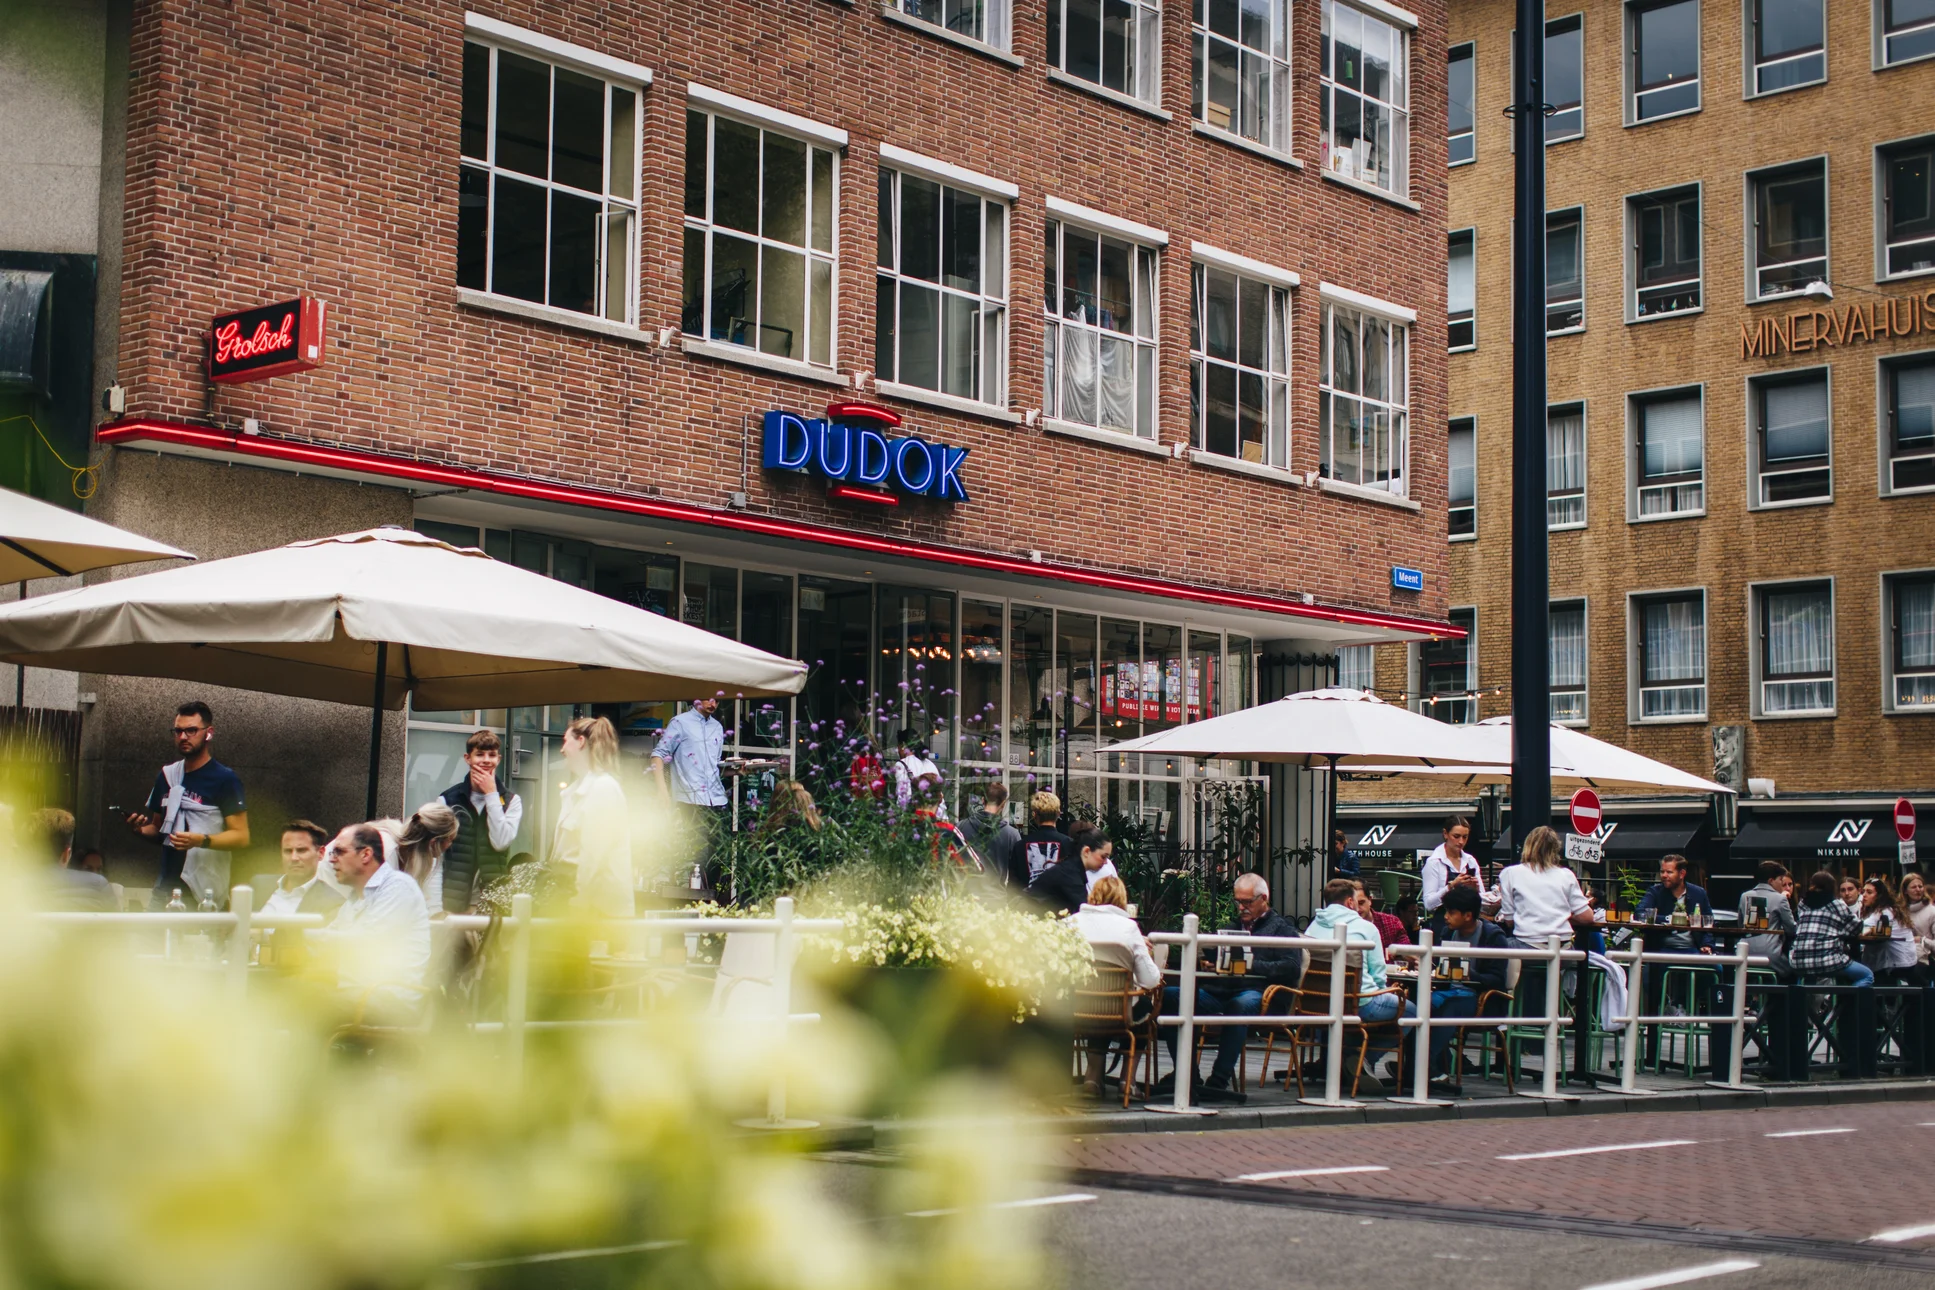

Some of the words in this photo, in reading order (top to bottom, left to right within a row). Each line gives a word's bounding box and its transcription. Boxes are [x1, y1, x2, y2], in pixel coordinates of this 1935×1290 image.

[214, 311, 295, 365] Grolsch
[1739, 288, 1935, 360] MINERVAHUIS
[766, 410, 970, 502] DUDOK
[1398, 571, 1419, 584] Meent
[1569, 836, 1600, 846] uitgezonderd
